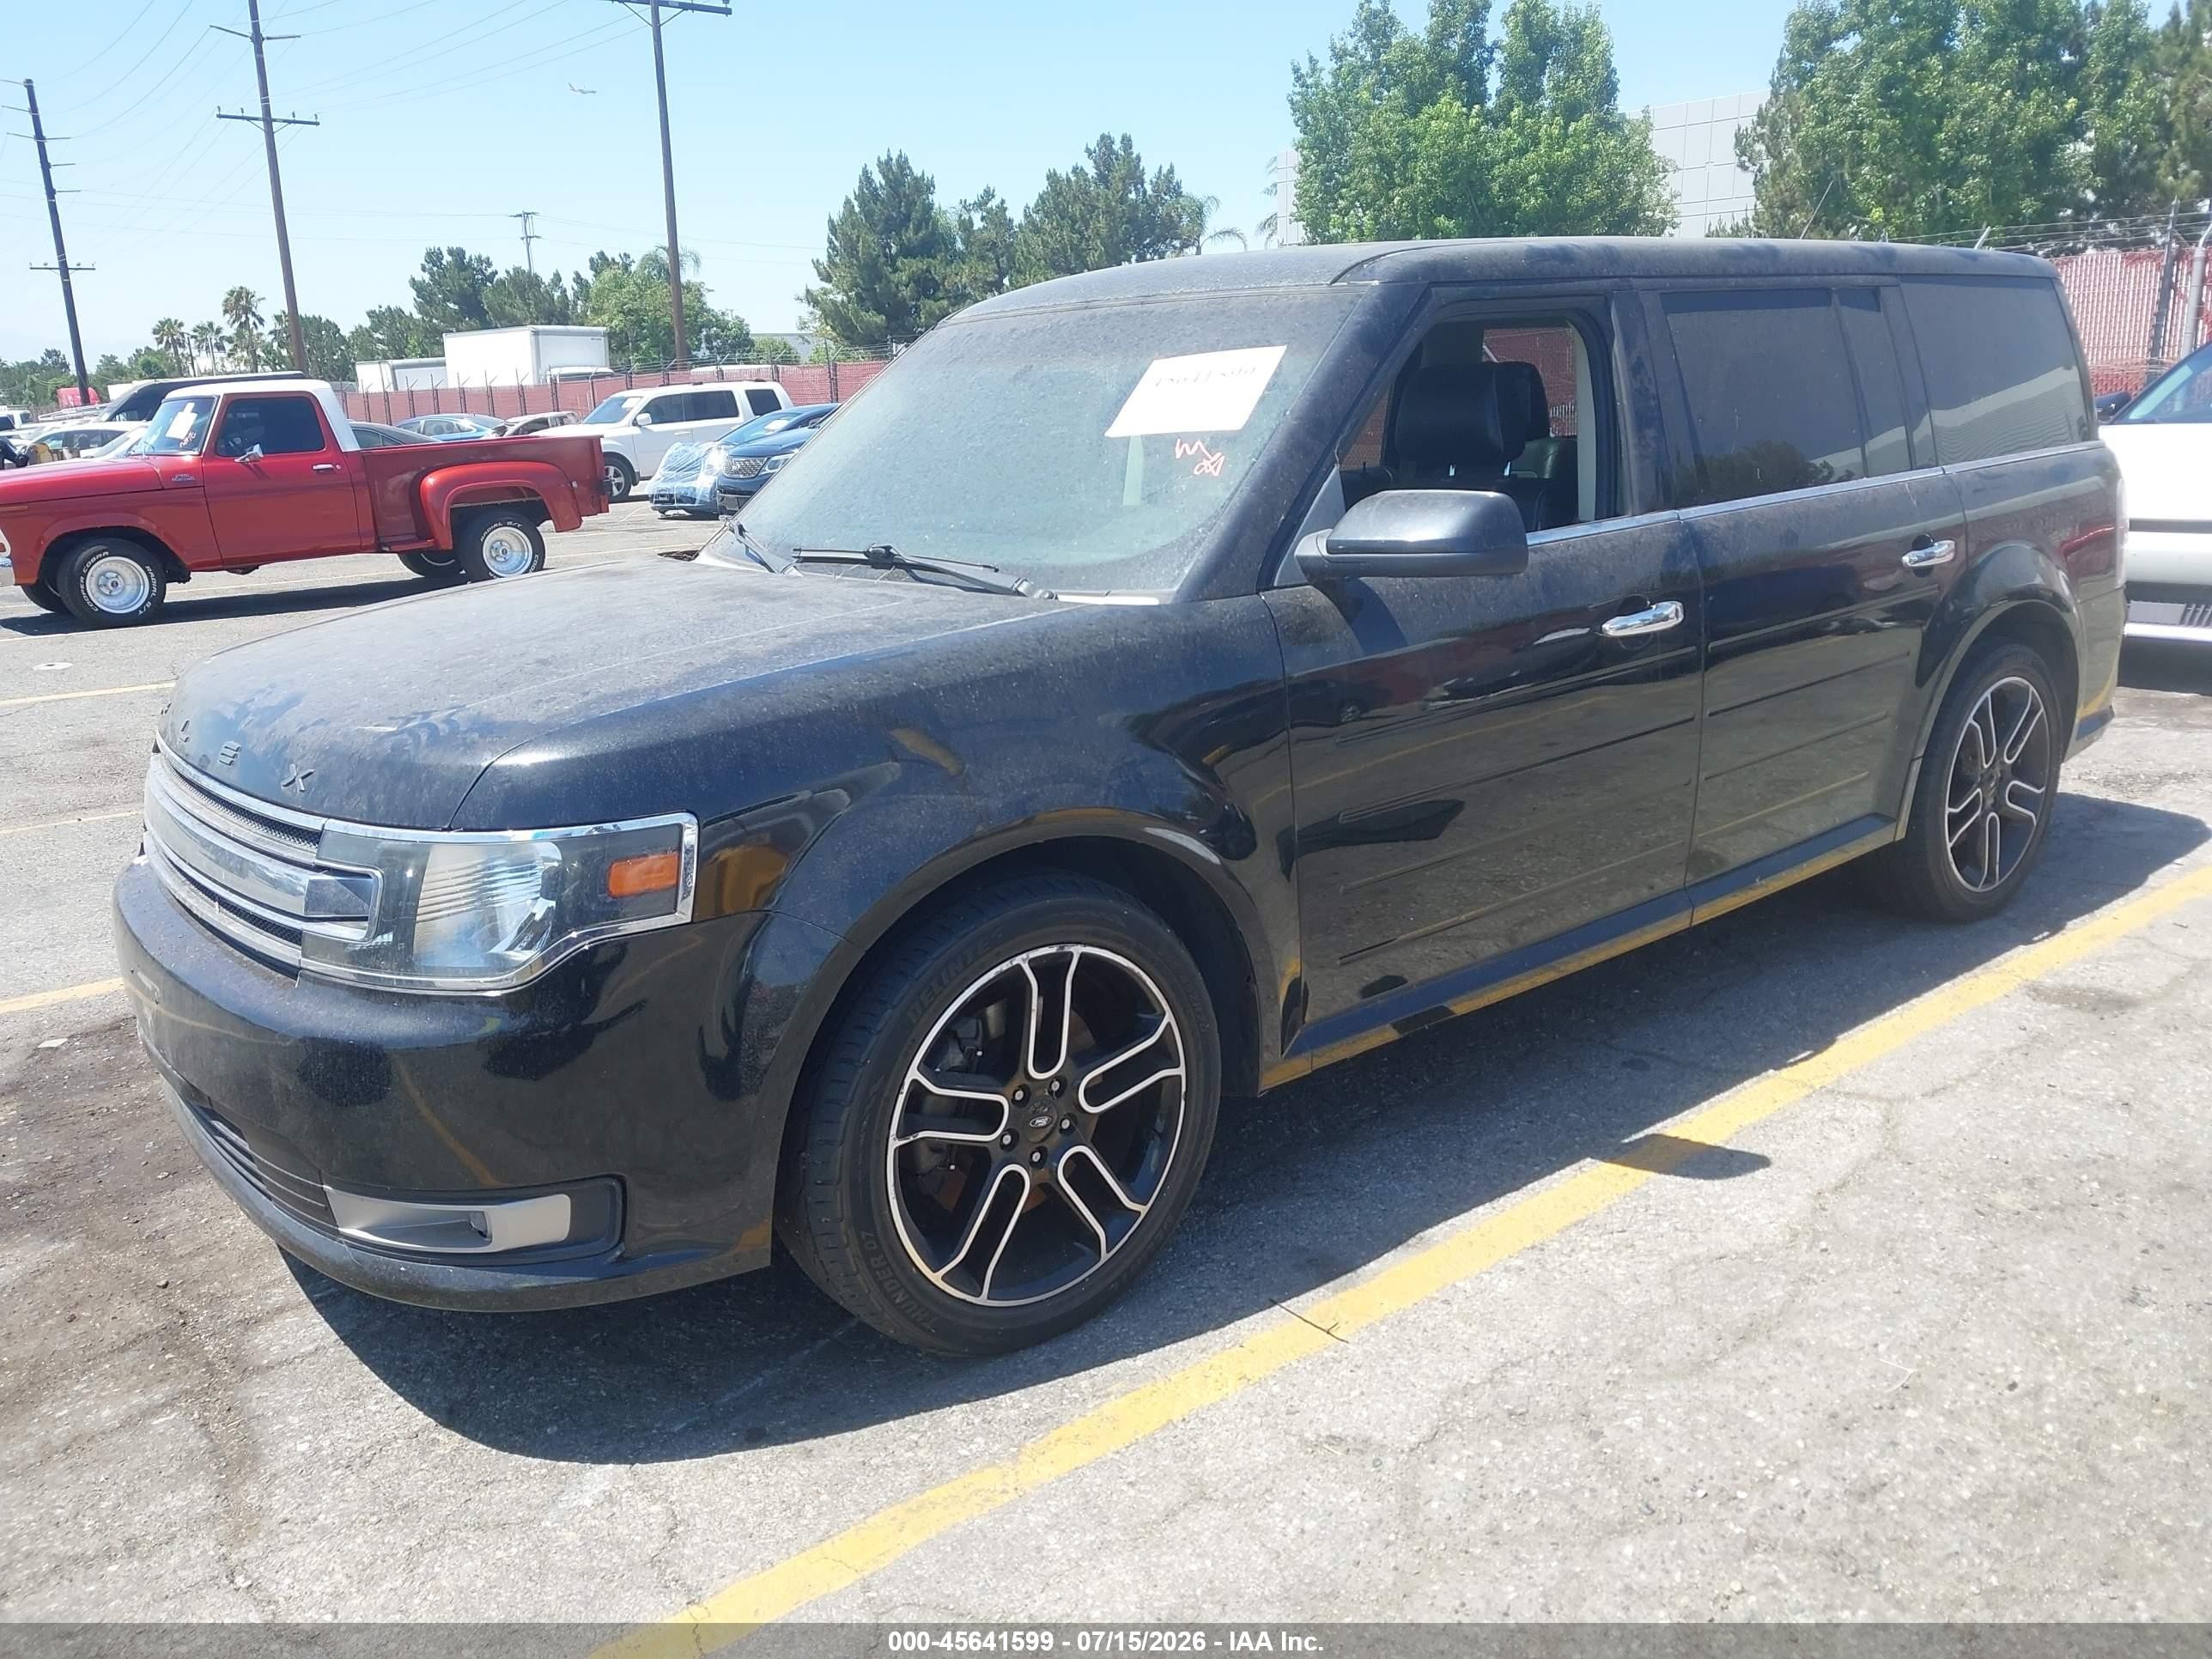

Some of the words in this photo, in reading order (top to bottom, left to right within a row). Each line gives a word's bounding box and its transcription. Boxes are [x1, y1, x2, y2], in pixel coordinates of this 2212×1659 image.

[480, 521, 503, 543] RADIAL
[82, 550, 109, 574] COBRA
[79, 576, 100, 612] COOPER
[145, 565, 157, 598] RADIAL
[870, 1255, 939, 1334] THUNDER
